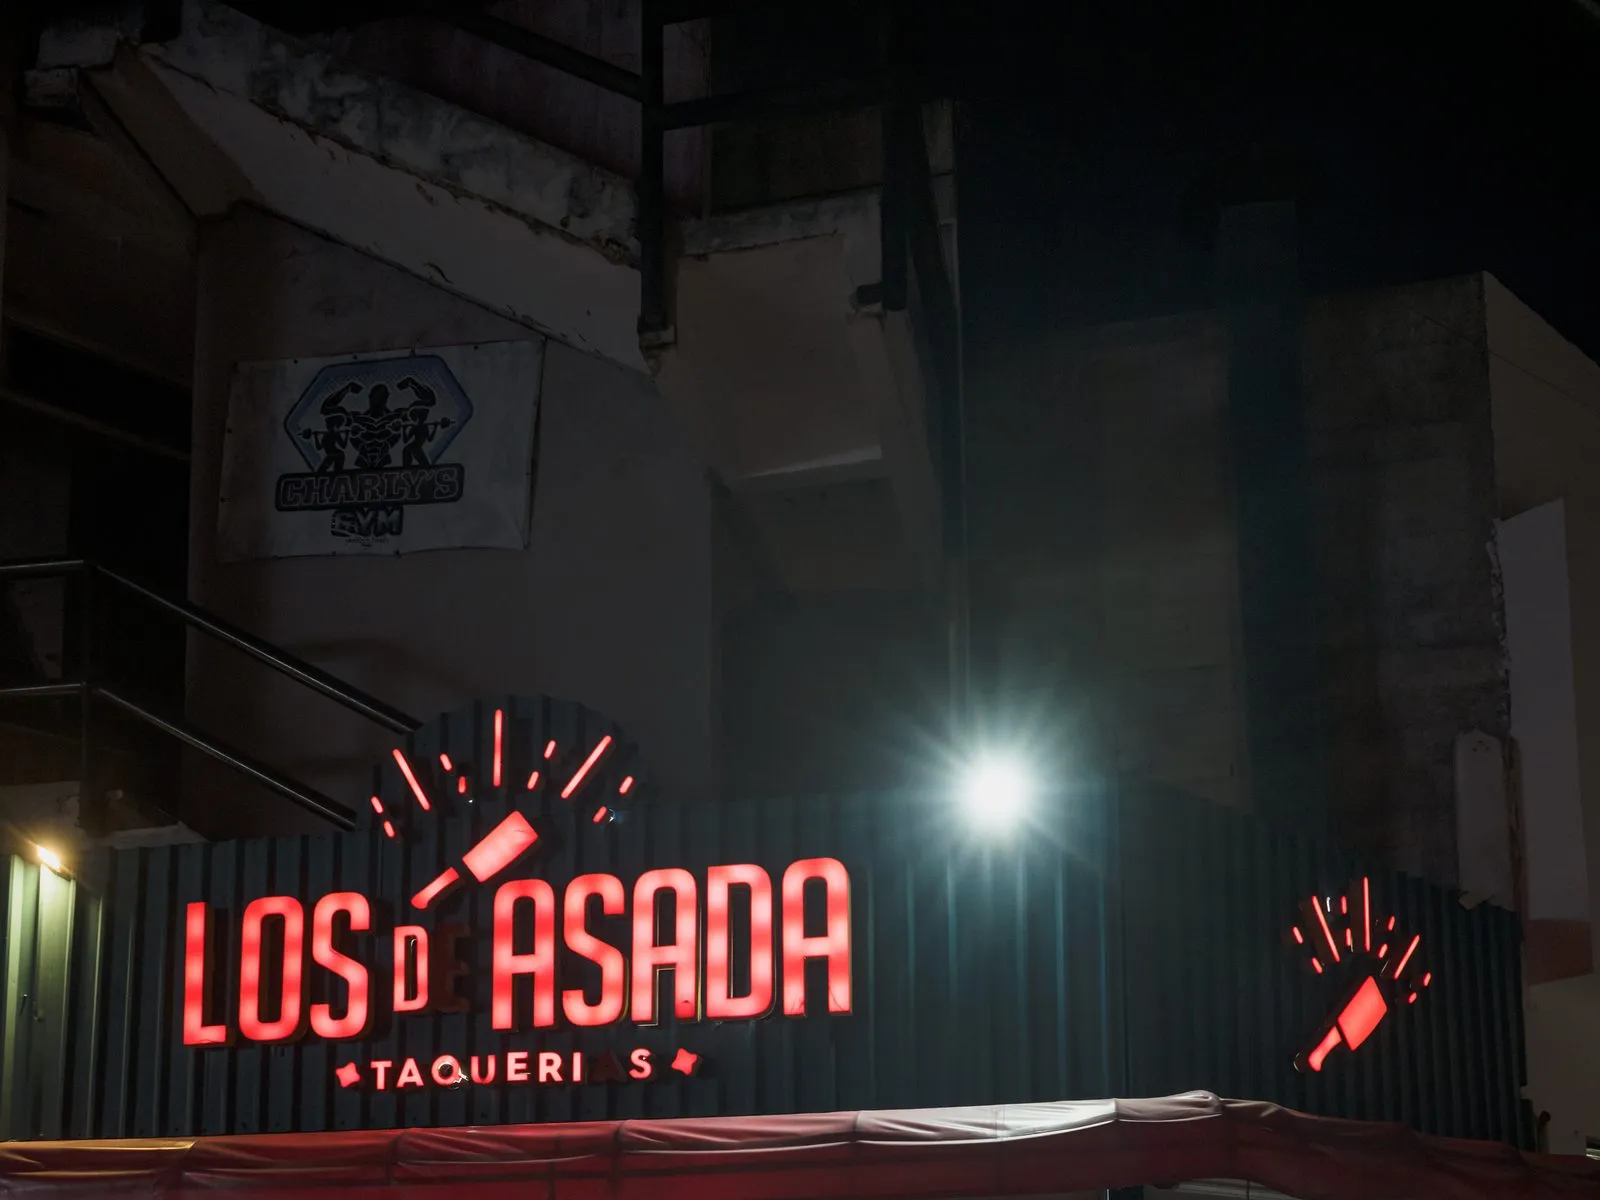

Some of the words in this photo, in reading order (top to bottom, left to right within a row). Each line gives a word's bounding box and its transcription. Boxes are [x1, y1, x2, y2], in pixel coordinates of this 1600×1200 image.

[280, 468, 459, 507] CHARLY'S
[331, 506, 403, 537] GYM
[183, 892, 370, 1047] LOS
[492, 858, 852, 1030] ASADA
